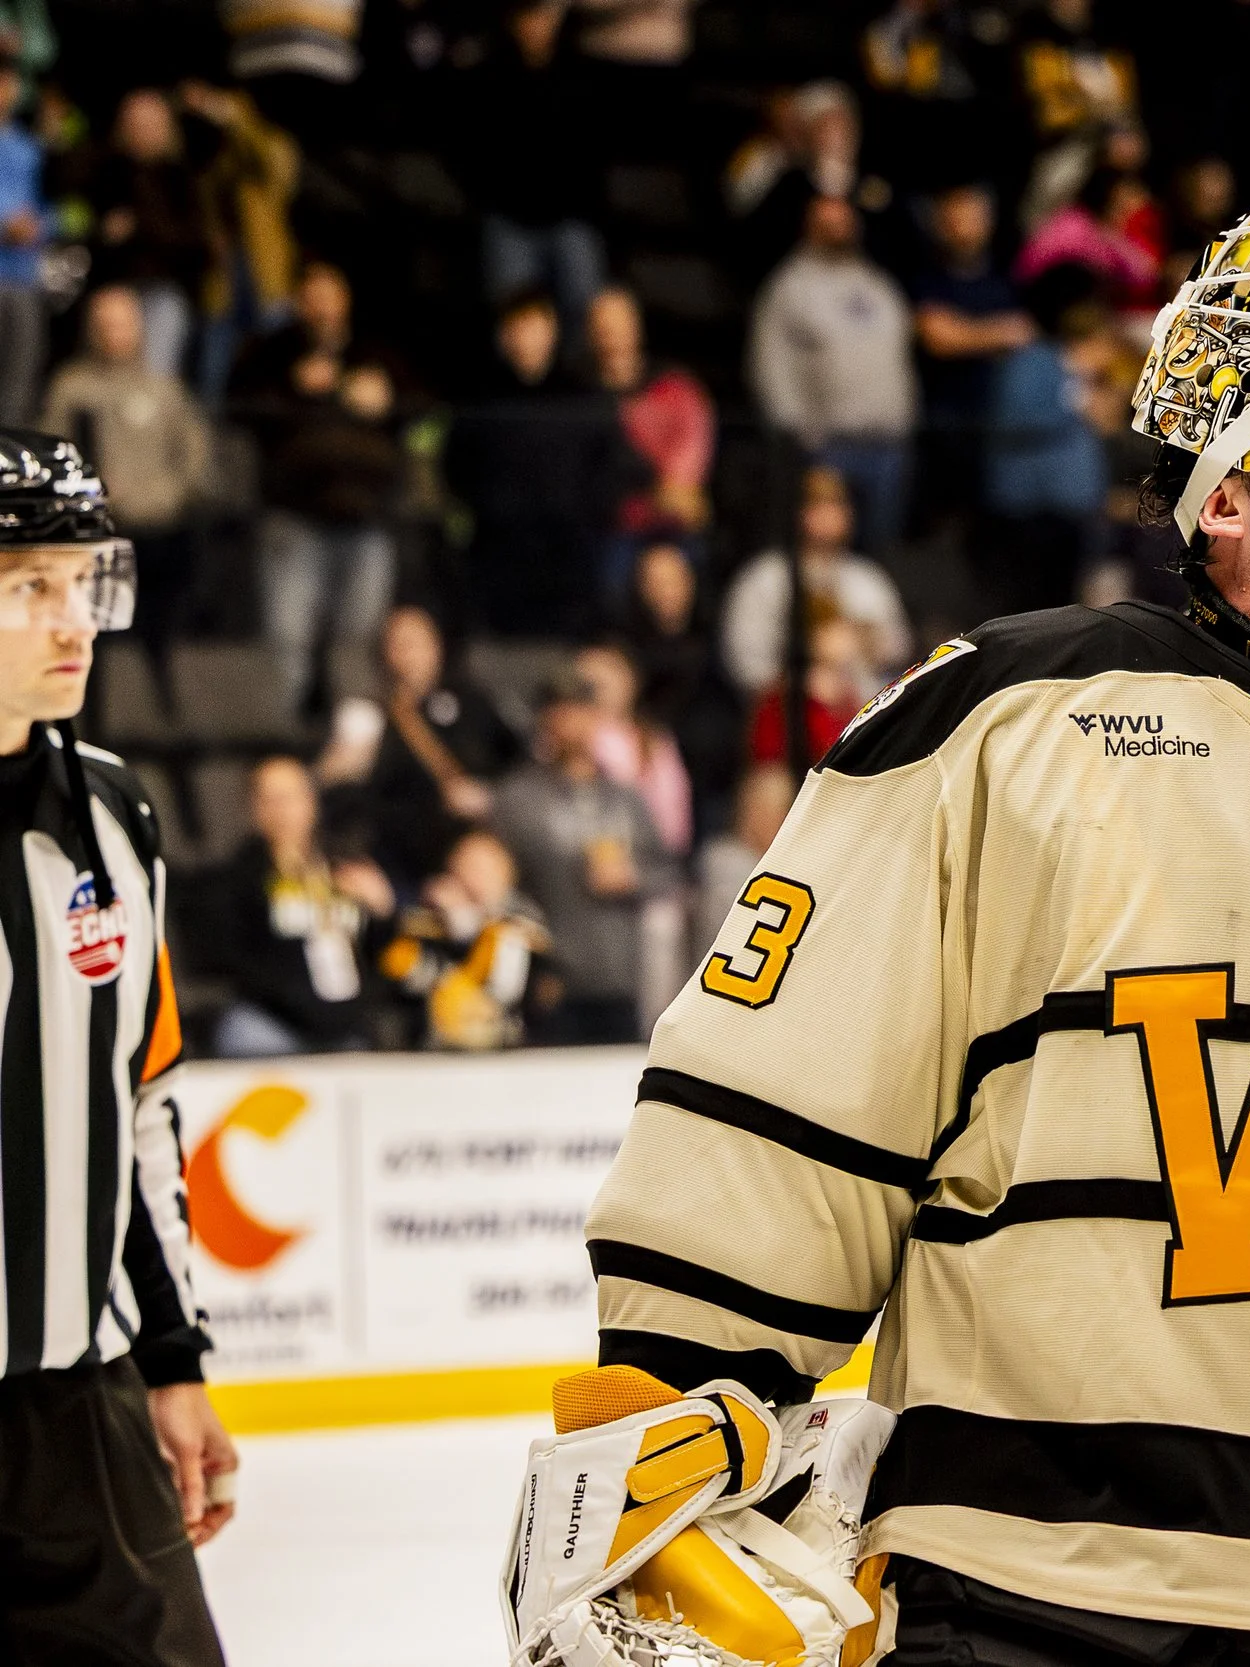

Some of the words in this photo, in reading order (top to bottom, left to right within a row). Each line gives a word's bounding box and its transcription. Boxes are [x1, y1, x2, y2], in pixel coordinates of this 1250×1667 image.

[1099, 714, 1163, 734] WVU
[1104, 735, 1210, 757] Medicine
[700, 871, 817, 1010] 3
[564, 1473, 588, 1559] GAUTHIER
